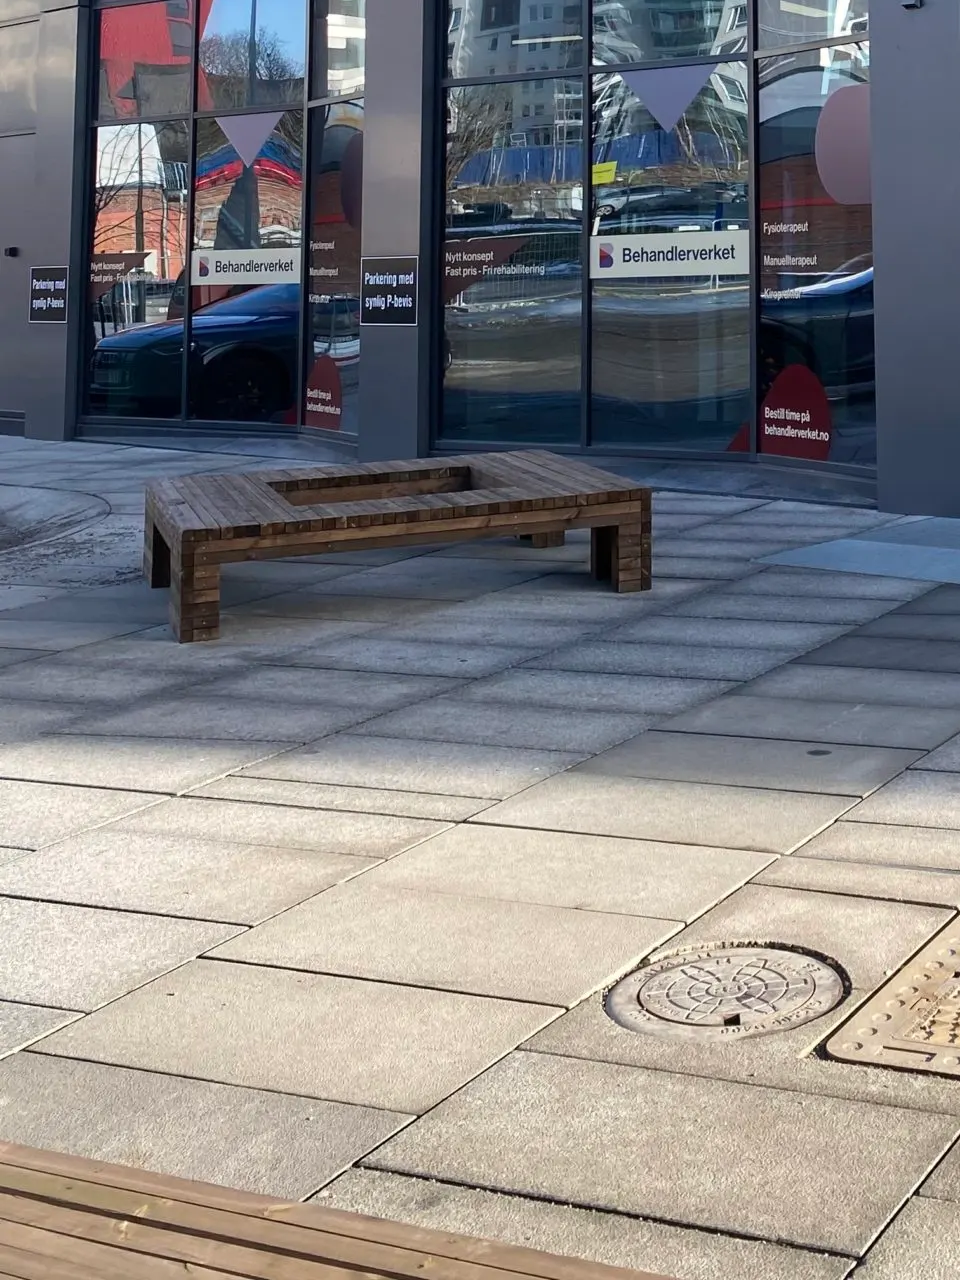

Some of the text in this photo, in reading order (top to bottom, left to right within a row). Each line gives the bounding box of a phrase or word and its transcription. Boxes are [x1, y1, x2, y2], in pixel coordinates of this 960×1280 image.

[763, 221, 809, 235] Fysioterapeut
[445, 251, 494, 263] Nytt konsept
[622, 244, 736, 263] Behandlerverket
[214, 259, 294, 273] Behandlerverket
[445, 266, 462, 276] Fast
[462, 265, 478, 277] pris
[482, 265, 493, 275] Fri
[364, 271, 414, 287] Parkering med
[365, 293, 413, 310] synlig P-bevis
[764, 407, 811, 424] Bestill time på
[764, 423, 830, 441] behandlerverket.no
